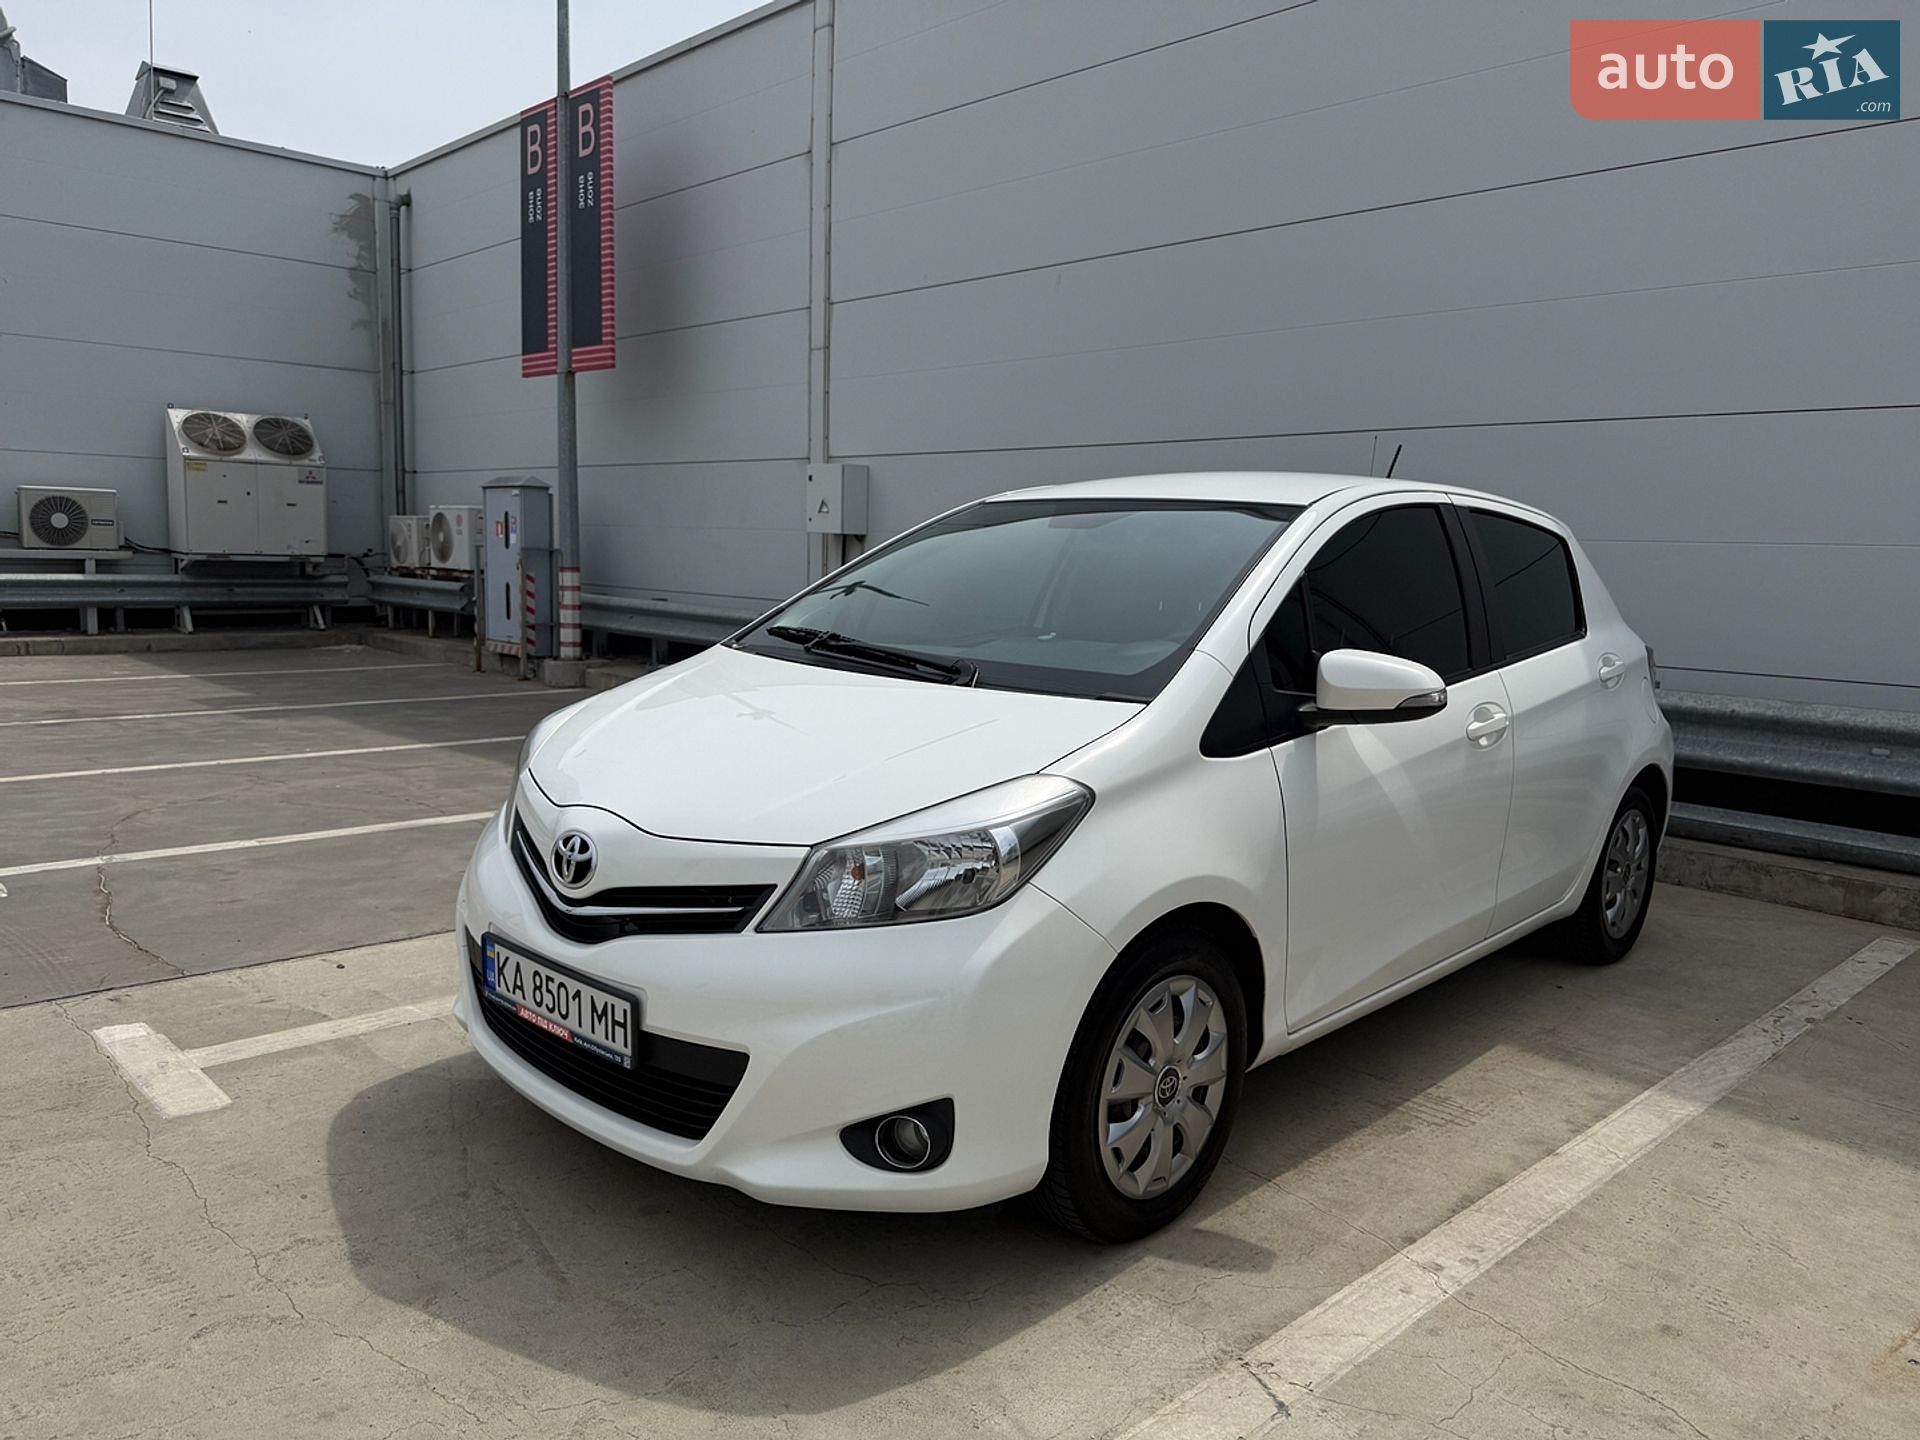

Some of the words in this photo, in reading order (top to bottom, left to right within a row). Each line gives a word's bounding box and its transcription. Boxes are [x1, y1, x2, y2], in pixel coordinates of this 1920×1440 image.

[527, 124, 542, 175] B
[578, 103, 594, 157] B
[496, 951, 526, 1001] KA
[532, 969, 582, 1028] 8501
[591, 995, 629, 1049] MH
